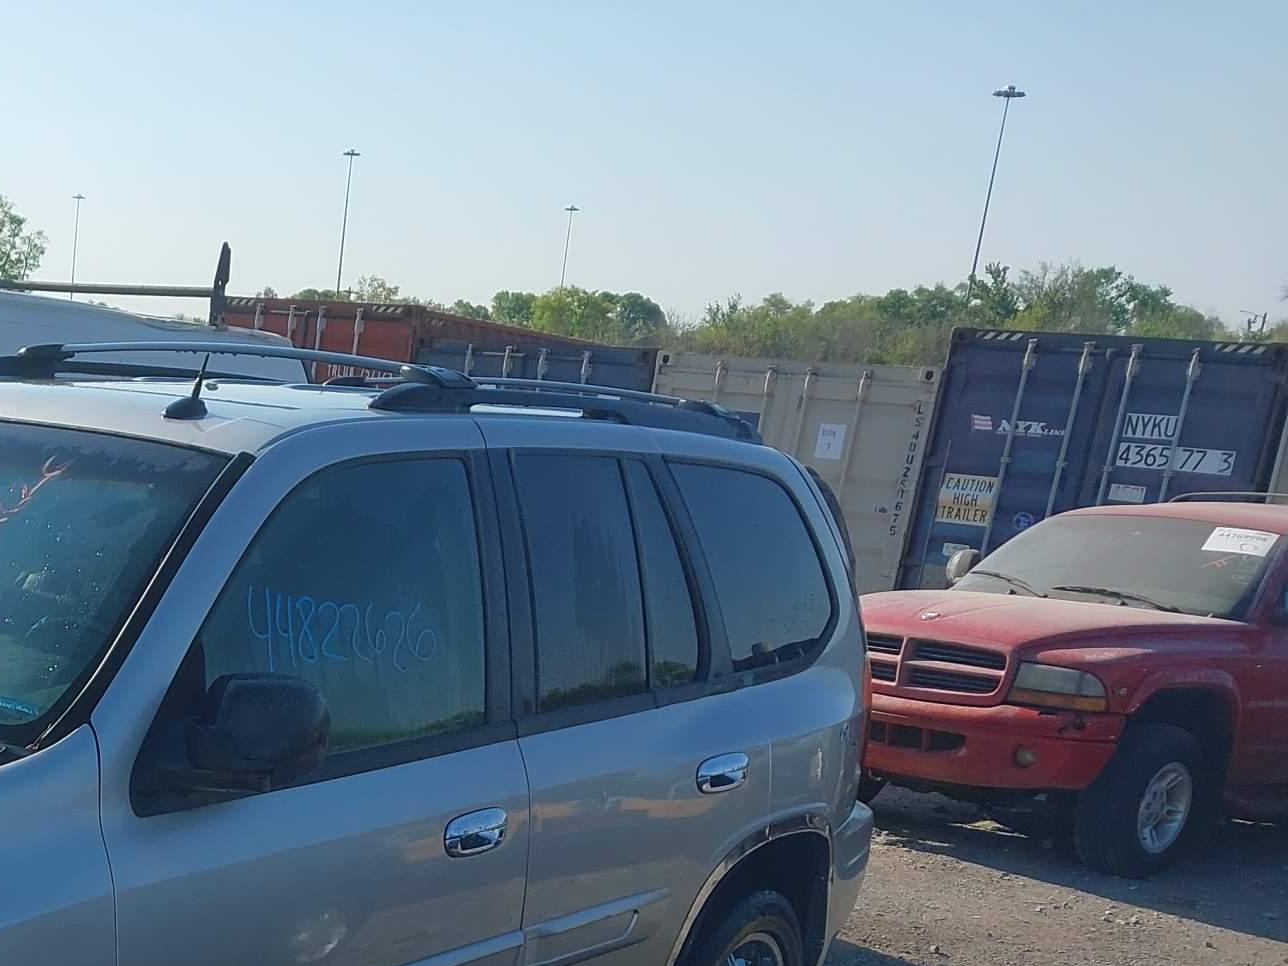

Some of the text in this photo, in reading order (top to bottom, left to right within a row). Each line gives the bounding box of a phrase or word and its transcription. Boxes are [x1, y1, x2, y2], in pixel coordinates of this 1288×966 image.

[997, 419, 1047, 434] NYK
[1125, 415, 1179, 438] NYKU
[1218, 452, 1234, 473] 3
[945, 477, 995, 494] CAUTION
[952, 492, 979, 507] HIGH
[940, 505, 988, 524] TRAILER
[247, 586, 437, 673] 44822626
